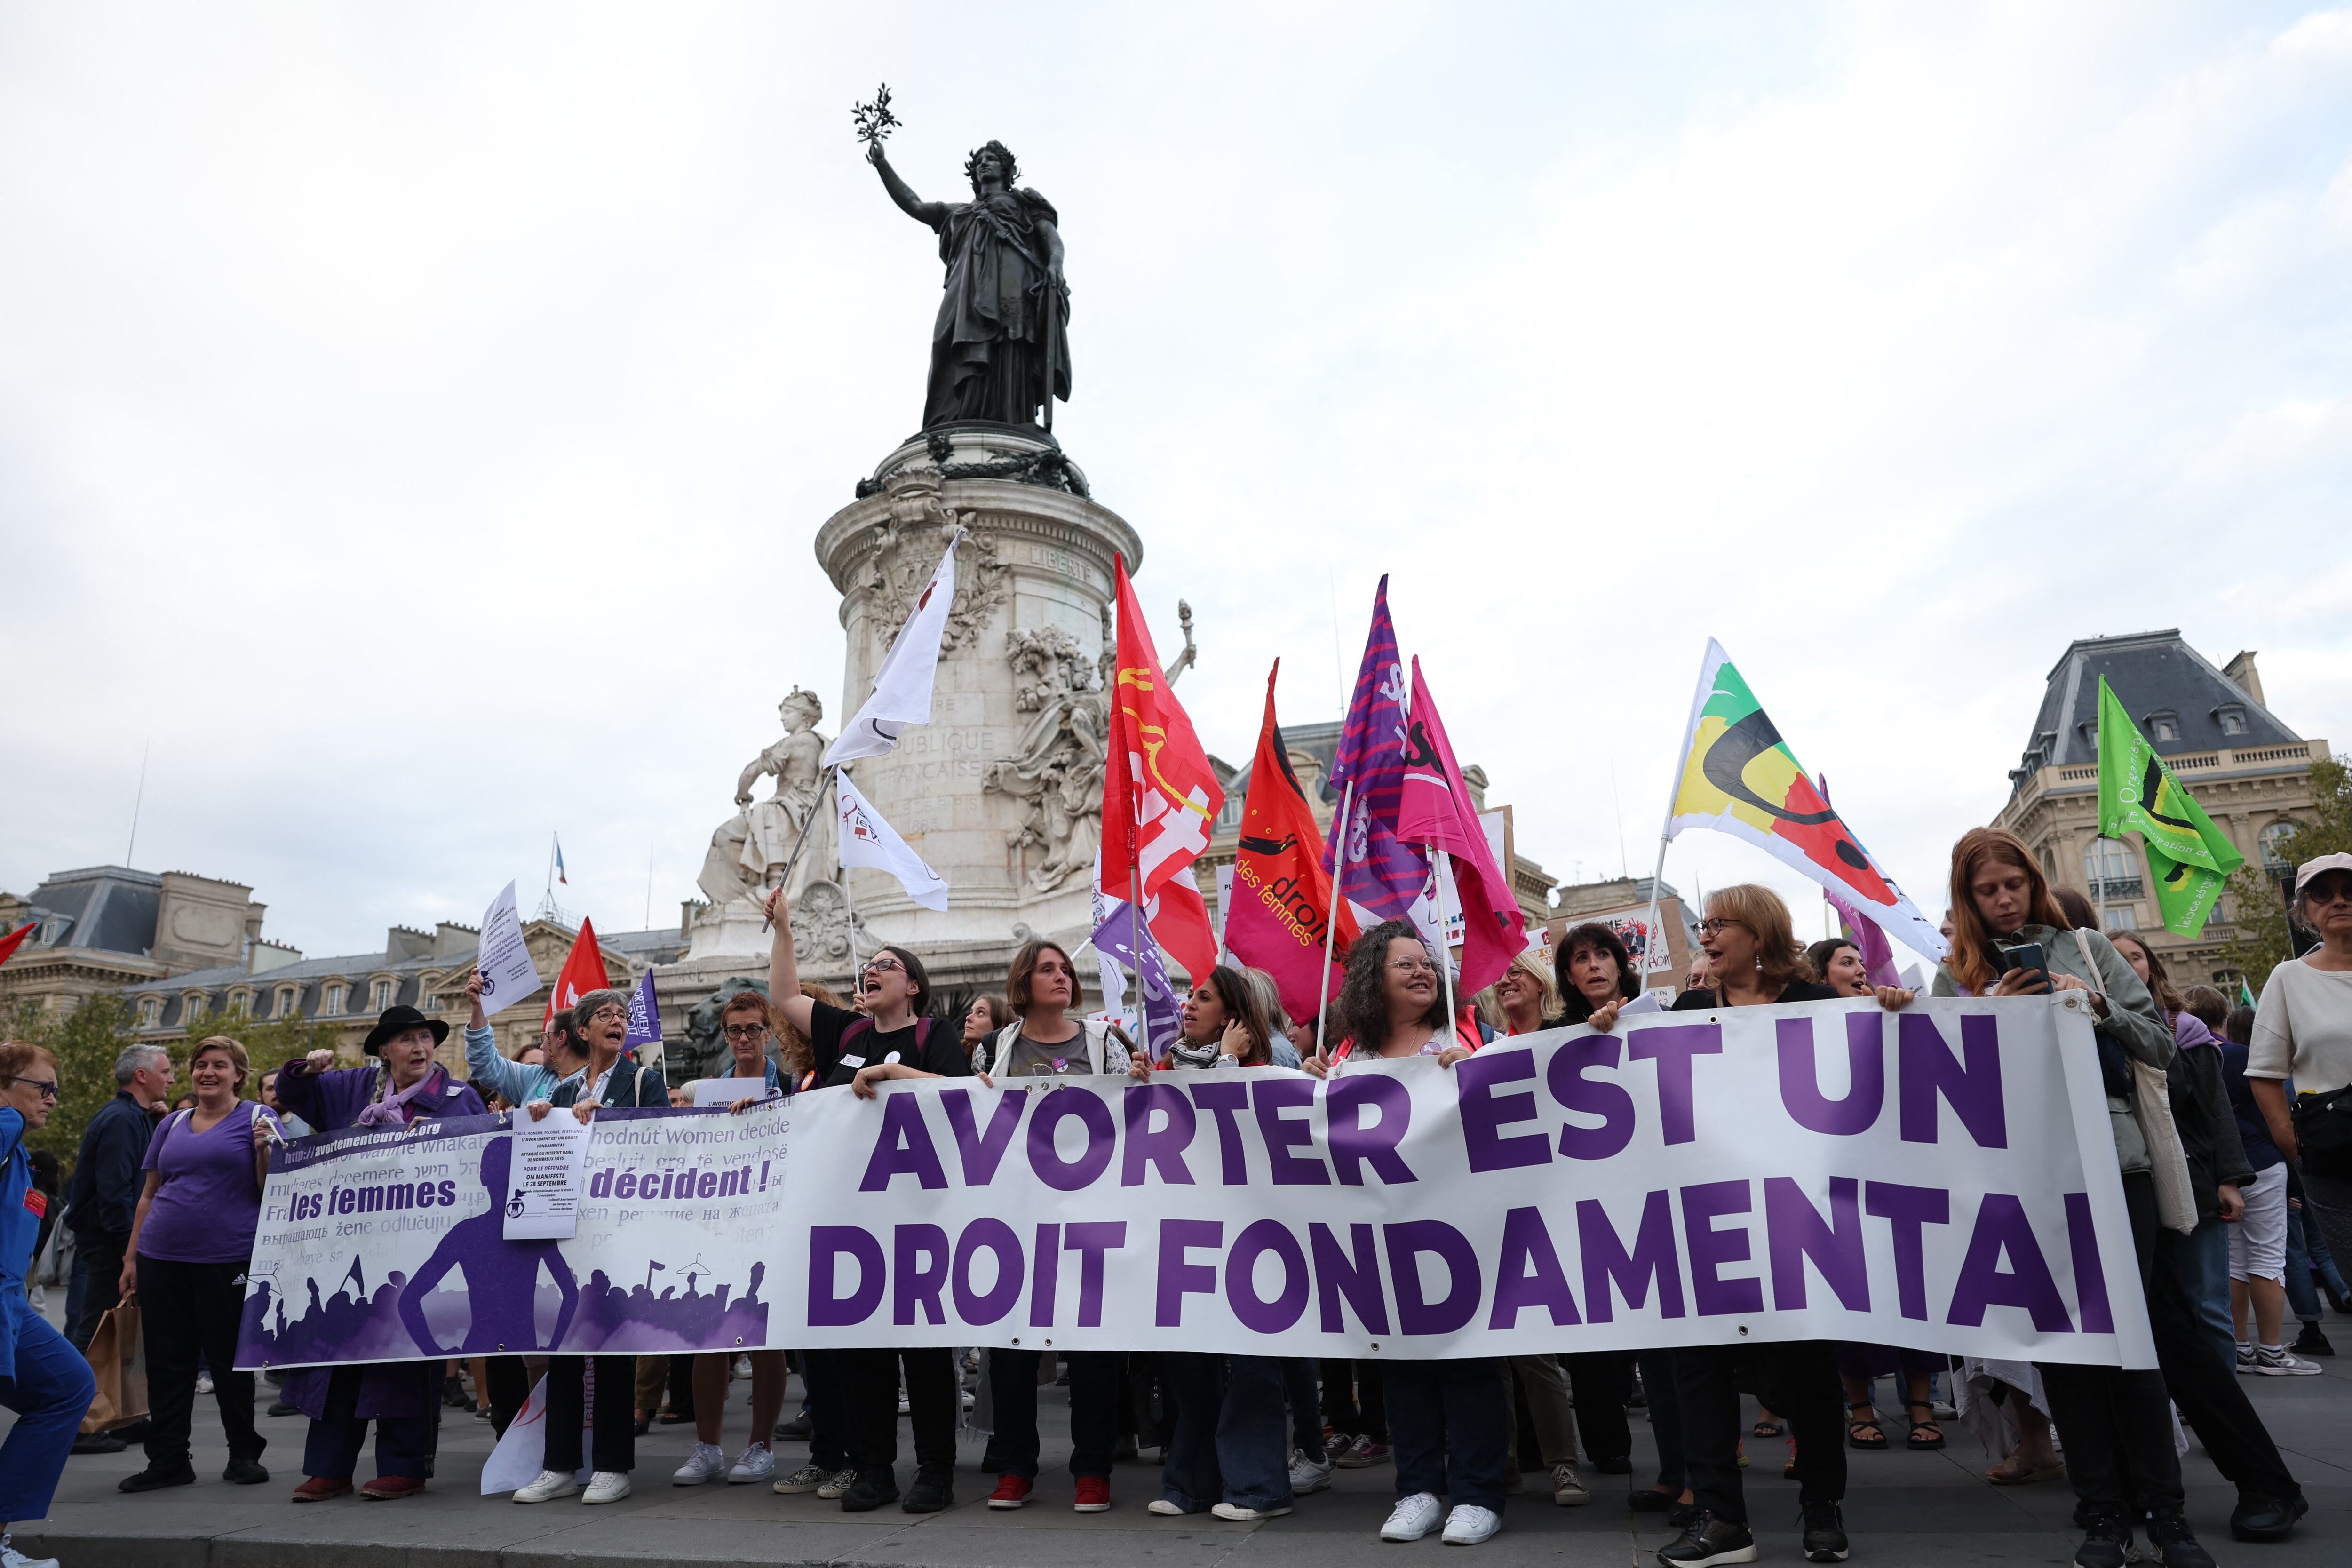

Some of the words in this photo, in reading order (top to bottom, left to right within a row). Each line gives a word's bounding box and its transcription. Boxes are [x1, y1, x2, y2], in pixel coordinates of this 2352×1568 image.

[894, 733, 993, 755] PUBLIQUE
[2120, 730, 2143, 803] Organisat
[1235, 859, 1260, 888] des
[1257, 884, 1313, 946] femmes
[666, 1128, 735, 1144] Women
[739, 1116, 790, 1141] decide
[858, 1073, 1420, 1192] AVORTER
[1456, 1024, 1724, 1174] EST
[1775, 1011, 2008, 1150] UN
[289, 1192, 323, 1222] les
[328, 1180, 456, 1216] femmes
[590, 1165, 752, 1200] décident
[758, 1160, 771, 1193] !
[808, 1217, 1127, 1327] DROIT
